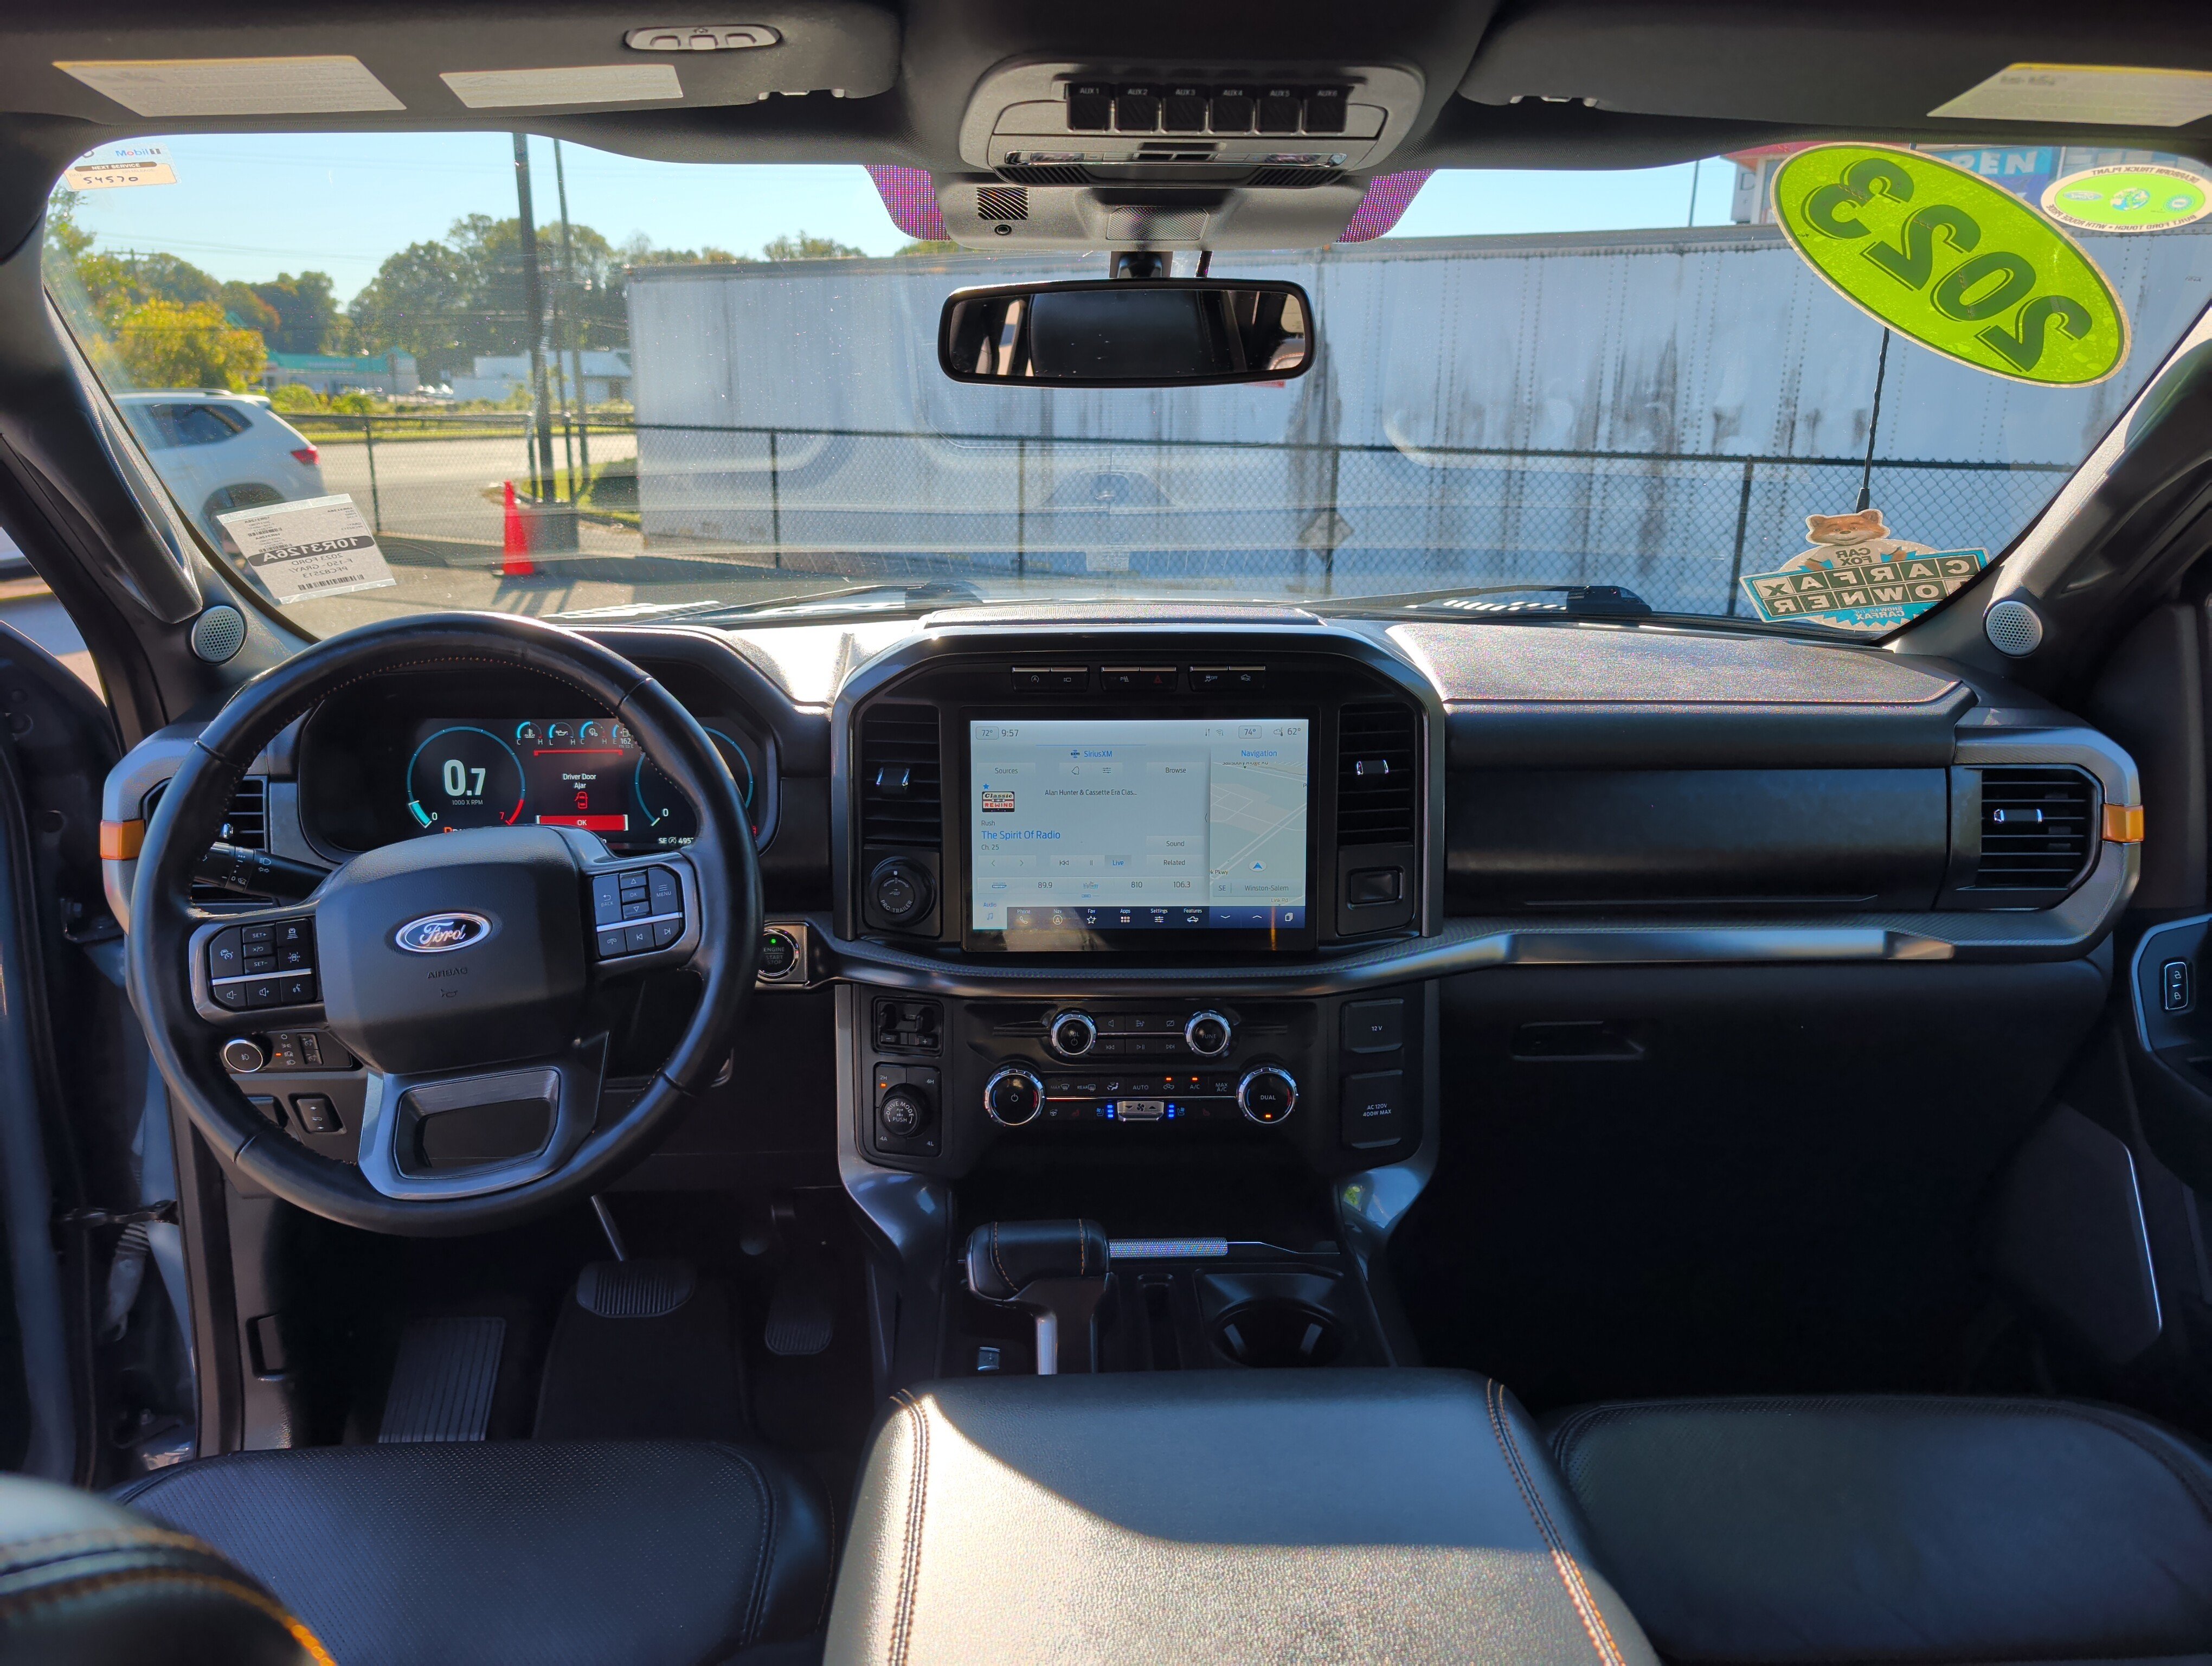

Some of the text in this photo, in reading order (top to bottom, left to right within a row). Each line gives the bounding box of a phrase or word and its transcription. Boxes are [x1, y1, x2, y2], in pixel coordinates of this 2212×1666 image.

[115, 149, 149, 157] Mobil
[83, 176, 139, 184] 54570
[1001, 729, 1019, 738] 9:57
[1241, 750, 1277, 758] Navigation
[443, 759, 486, 797] 0.7
[432, 812, 438, 821] 0
[499, 811, 505, 820] 7
[663, 809, 669, 817] 0
[981, 830, 1060, 841] The Spirit Of Radio
[880, 900, 913, 913] PRO TRAILER
[419, 921, 467, 945] Ford
[427, 967, 467, 979] AIRBAG
[886, 1100, 914, 1117] DRIVE MODE
